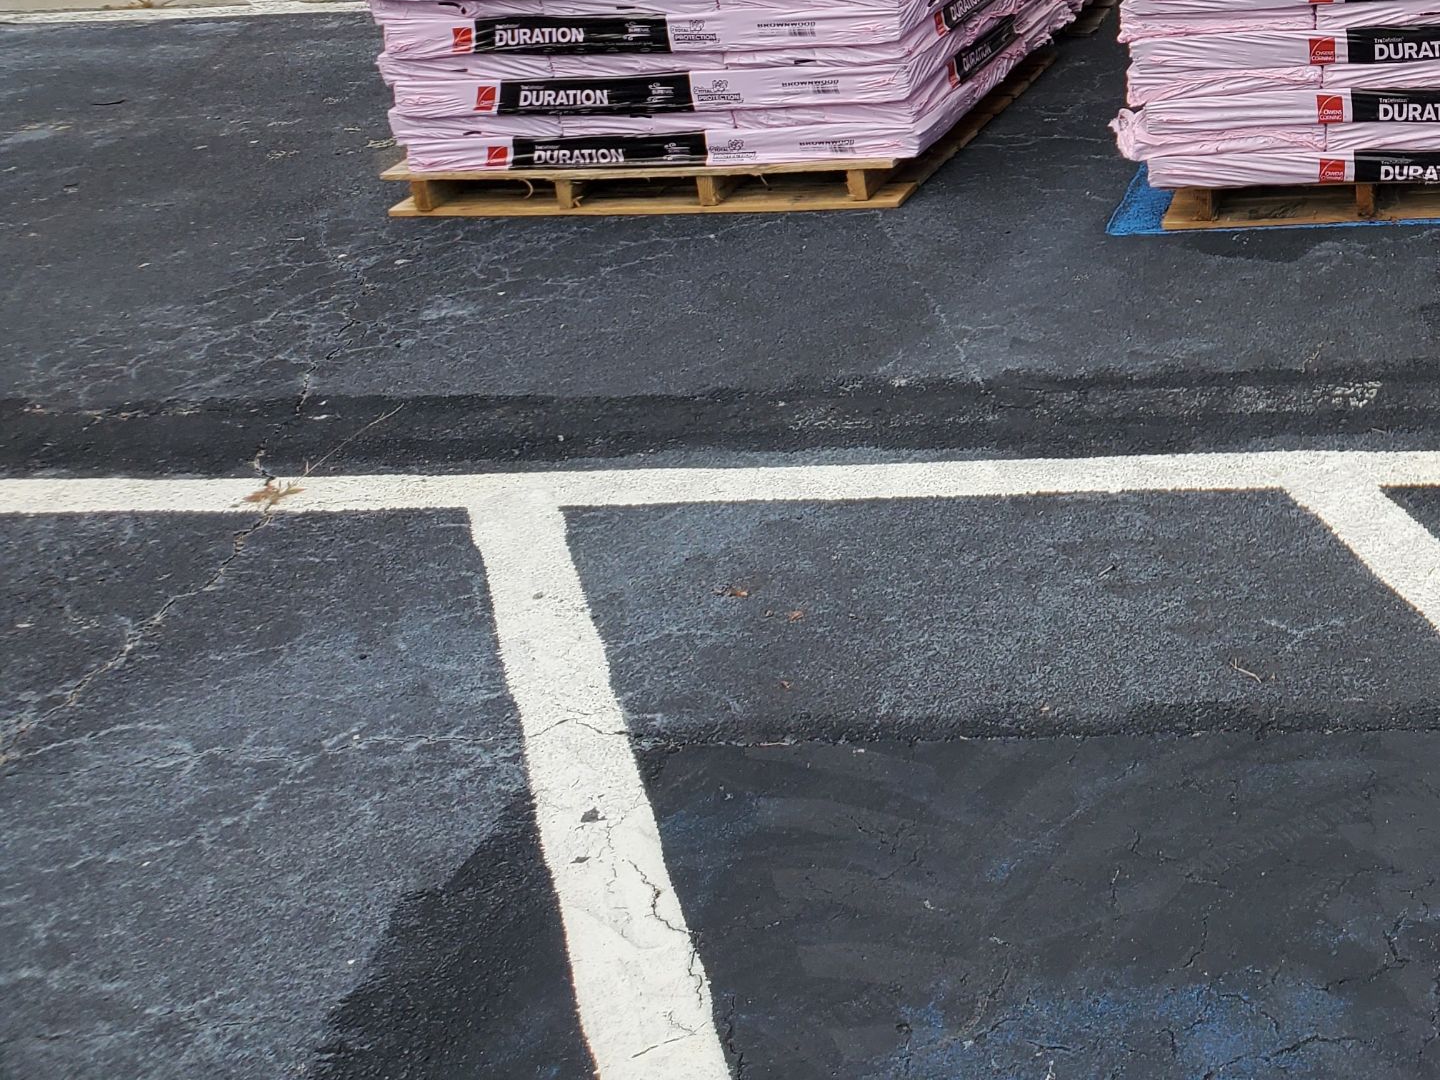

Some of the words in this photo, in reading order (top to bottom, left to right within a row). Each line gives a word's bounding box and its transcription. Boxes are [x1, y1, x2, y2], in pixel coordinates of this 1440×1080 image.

[495, 27, 585, 46] DURATION
[674, 33, 717, 42] PROTECTION
[518, 89, 609, 107] DURATION
[698, 92, 741, 101] PROTECTION
[533, 148, 625, 165] DURATION
